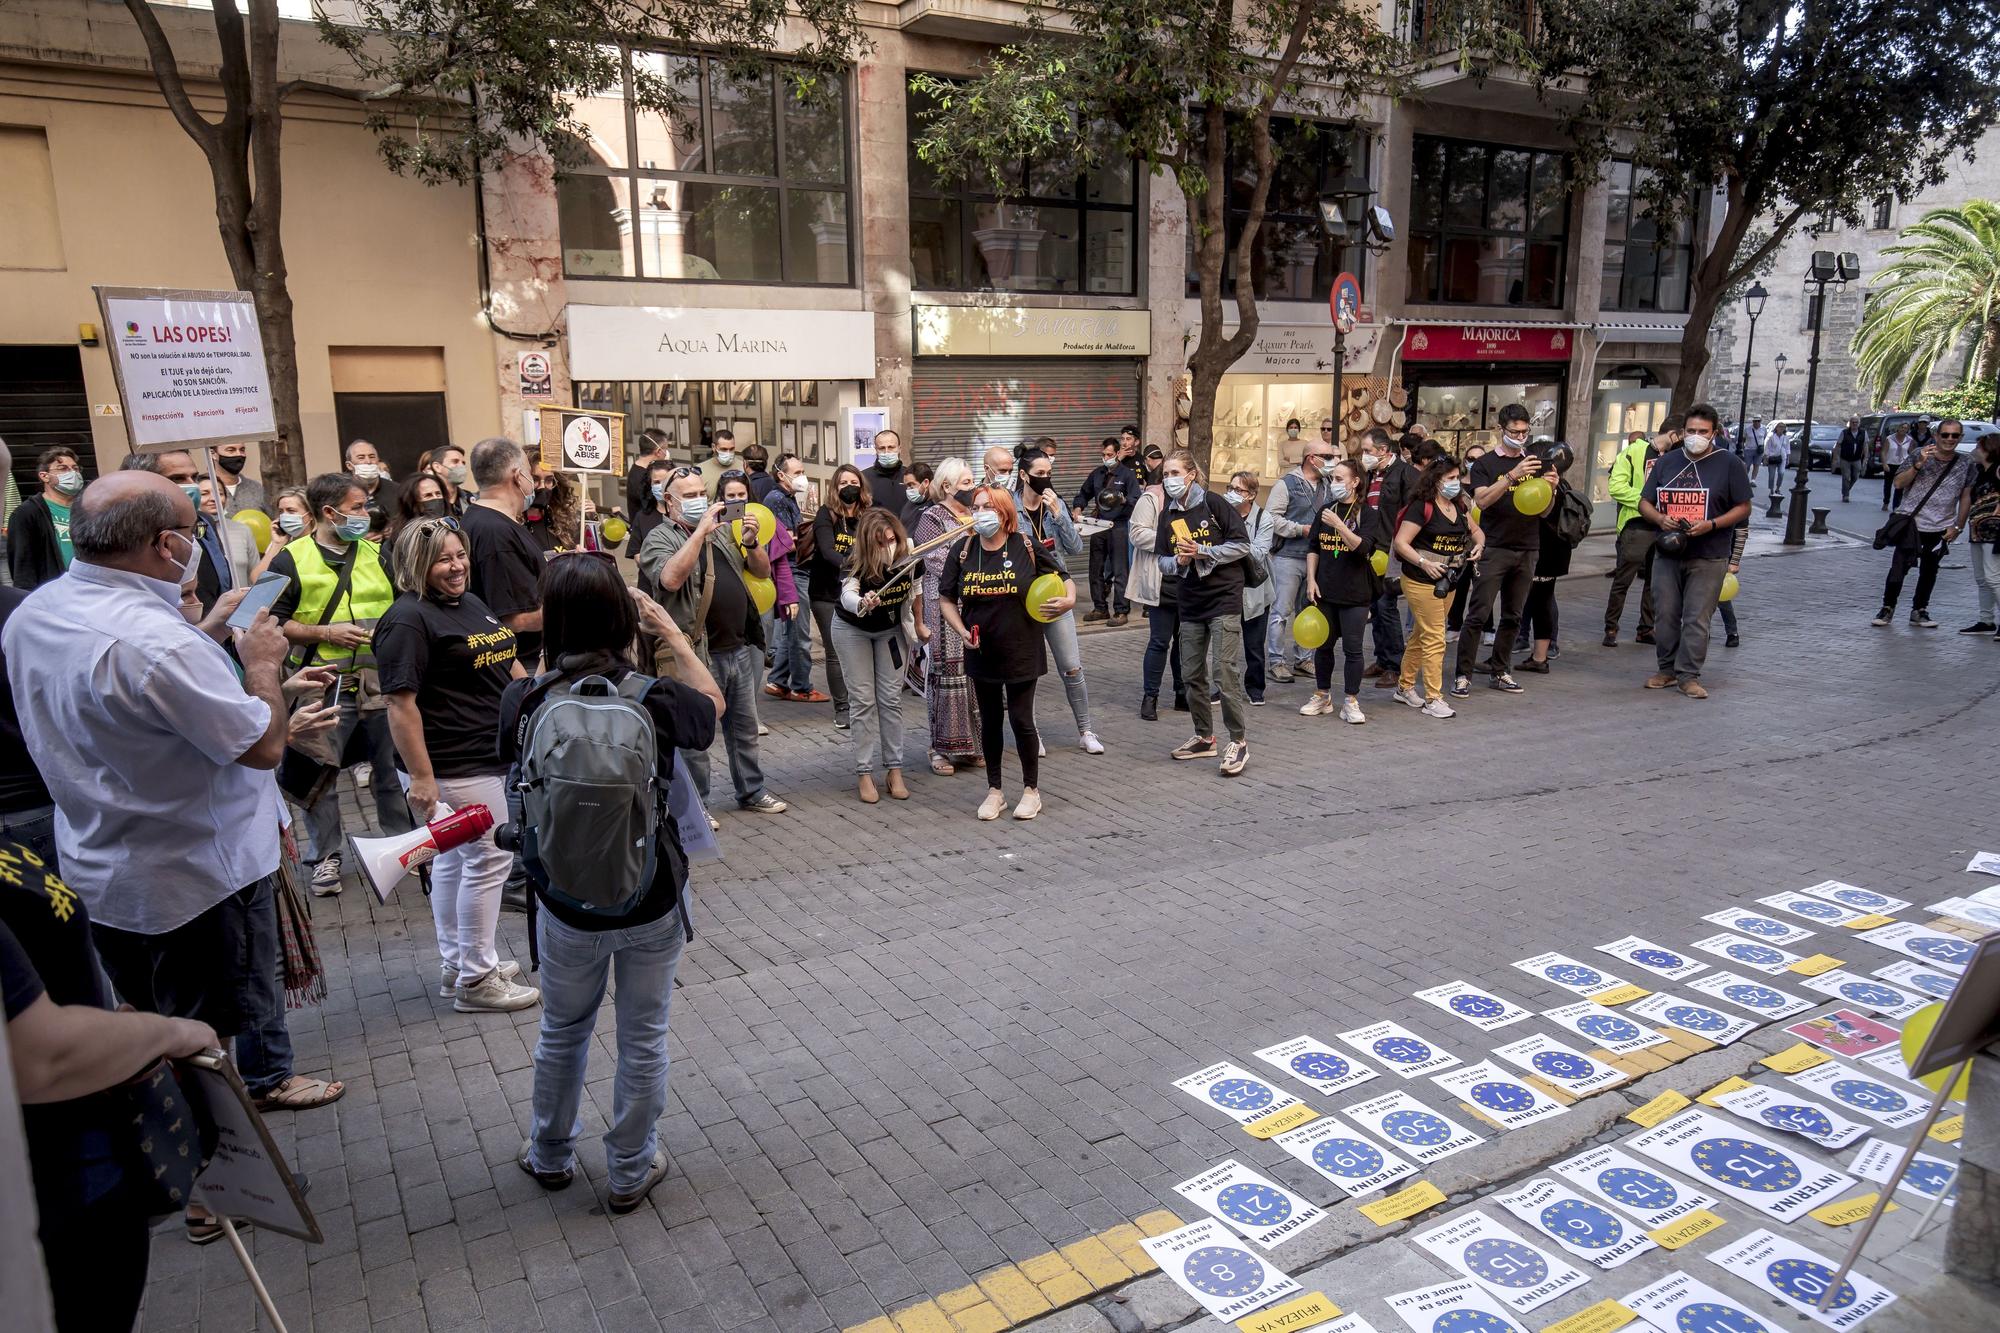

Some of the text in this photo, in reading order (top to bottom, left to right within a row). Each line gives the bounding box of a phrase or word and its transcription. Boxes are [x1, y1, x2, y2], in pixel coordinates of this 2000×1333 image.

[153, 326, 183, 343] LAS
[186, 326, 232, 343] OPES!
[1461, 326, 1521, 342] MAJORICA
[1062, 342, 1136, 351] Productes de Mallorca
[1290, 339, 1315, 350] Pearls
[158, 351, 181, 359] solución
[1264, 356, 1301, 366] Majorca
[160, 366, 233, 377] El TJUE ya lo dejó claro,
[172, 379, 183, 387] NO
[198, 376, 228, 386] SANCIÓN.
[142, 388, 183, 399] APLICACIÓN
[183, 389, 192, 397] DE
[201, 387, 229, 396] Directiva
[229, 386, 259, 395] 1999/70CE
[574, 450, 600, 459] ABUSE
[577, 444, 598, 452] STOP
[1659, 491, 1706, 504] SE VENDE
[964, 570, 1016, 582] #FijezaYa
[962, 584, 1018, 595] #FixesaJa
[516, 713, 529, 746] Canon
[1805, 905, 1829, 914] 15
[1748, 921, 1775, 931] 24
[1746, 949, 1770, 959] 17
[1928, 943, 1967, 956] 23
[1648, 955, 1665, 963] 9
[1559, 969, 1587, 980] 29
[1578, 979, 1621, 993] INTERINA
[1739, 990, 1769, 1002] 26
[1859, 989, 1888, 1000] 14
[1465, 1001, 1492, 1011] 12
[1766, 1000, 1808, 1016] INTERINA
[1887, 998, 1927, 1015] INTERINA
[1480, 1009, 1524, 1025] INTERINA
[1682, 1011, 1710, 1025] 25
[1595, 1021, 1624, 1035] 27
[1714, 1020, 1749, 1040] INTERINA
[1611, 1034, 1662, 1050] INTERINA
[1390, 1045, 1418, 1056] 15
[1308, 1060, 1336, 1073] 13
[1401, 1055, 1451, 1072] INTERINA
[1552, 1060, 1572, 1070] 8
[1320, 1069, 1370, 1088] INTERINA
[1569, 1070, 1616, 1088] INTERINA
[1225, 1085, 1257, 1101] 23
[1496, 1092, 1514, 1103] 7
[1854, 1089, 1889, 1103] 16
[1242, 1097, 1295, 1122] INTERINA
[1503, 1103, 1557, 1123] INTERINA
[1306, 1120, 1335, 1132] FRAUDE
[1398, 1119, 1435, 1136] 30
[1637, 1113, 1702, 1146] FRAUDE DE LEY
[1778, 1112, 1815, 1131] 30
[1279, 1135, 1293, 1143] LEY
[1310, 1129, 1330, 1139] AÑOS
[1663, 1126, 1702, 1146] AÑOS EN
[1417, 1135, 1475, 1158] INTERINA
[1583, 1148, 1612, 1161] FRAUDE
[1334, 1149, 1367, 1167] 19
[1590, 1157, 1610, 1167] AÑOS
[1726, 1154, 1774, 1177] 13
[1207, 1163, 1236, 1178] FRAUDE
[1558, 1164, 1573, 1172] LEY
[1212, 1173, 1232, 1185] AÑOS
[1348, 1164, 1409, 1191] INTERINA
[1181, 1183, 1196, 1192] LEY
[1622, 1180, 1658, 1198] 13
[1770, 1173, 1840, 1212] INTERINA
[1238, 1195, 1272, 1215] 21
[1648, 1196, 1706, 1224] INTERINA
[1259, 1208, 1317, 1242] INTERINA
[1426, 1216, 1480, 1242] FRAU DE LLEI
[1459, 1226, 1481, 1238] ANYS
[1567, 1218, 1592, 1234] 6
[1662, 1217, 1714, 1245] #FIJEZA YA
[1152, 1224, 1212, 1248] FRAU DE LLEI
[1171, 1233, 1210, 1251] ANYS EN
[1745, 1235, 1773, 1251] FRAUDE
[1592, 1234, 1648, 1264] NTERINA
[1754, 1247, 1774, 1259] AÑOS
[1489, 1253, 1529, 1274] 15
[1722, 1255, 1737, 1264] LEY
[1210, 1264, 1235, 1280] 8
[1513, 1271, 1579, 1305] INTERINA
[1793, 1272, 1831, 1293] 10
[1219, 1280, 1292, 1314] INTERINA
[1394, 1283, 1471, 1306] FRAUDE DE LEY
[1435, 1294, 1462, 1306] AÑOS
[1628, 1276, 1688, 1309] FRAUDE DE LEY
[1652, 1289, 1688, 1309] AÑOS EN
[1833, 1291, 1888, 1325] INTERINA
[1255, 1302, 1322, 1333] #FIJEZA YA
